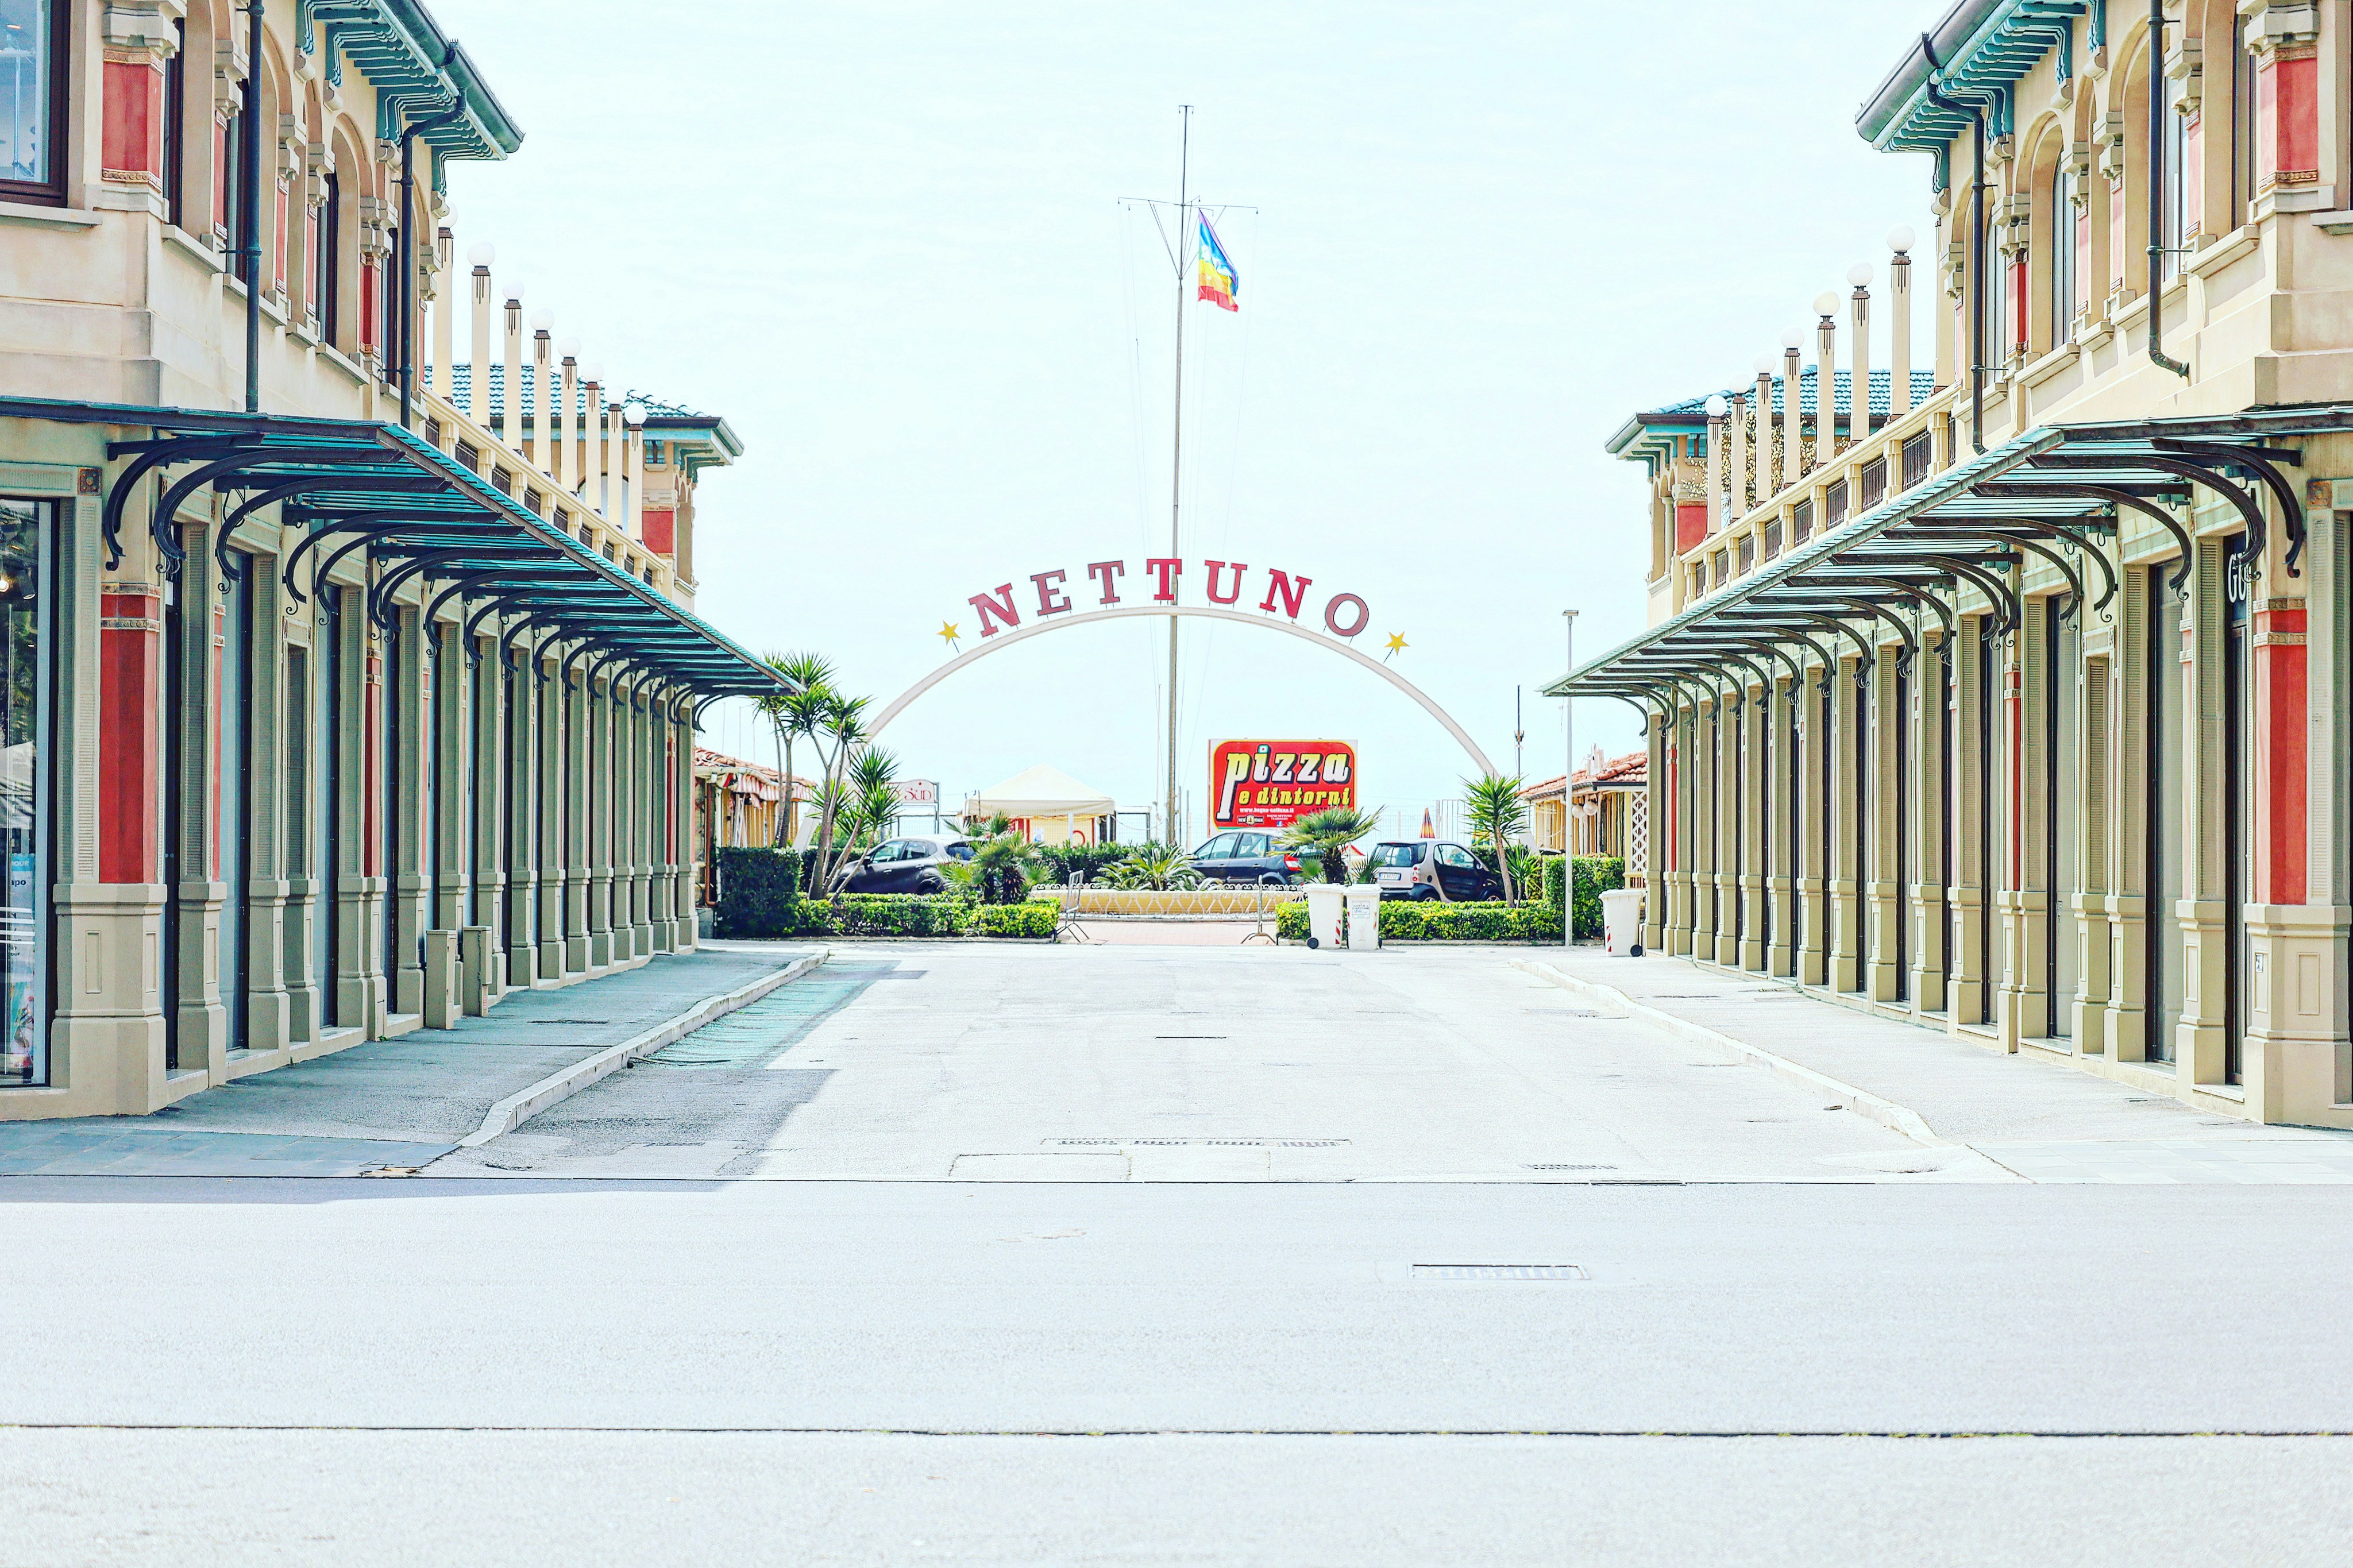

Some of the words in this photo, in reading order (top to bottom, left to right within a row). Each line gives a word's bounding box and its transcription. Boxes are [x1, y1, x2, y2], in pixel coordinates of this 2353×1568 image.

[969, 558, 1369, 638] NETTUNO
[1216, 744, 1351, 821] pizza
[1238, 790, 1251, 805] e
[1256, 787, 1351, 805] dintorni
